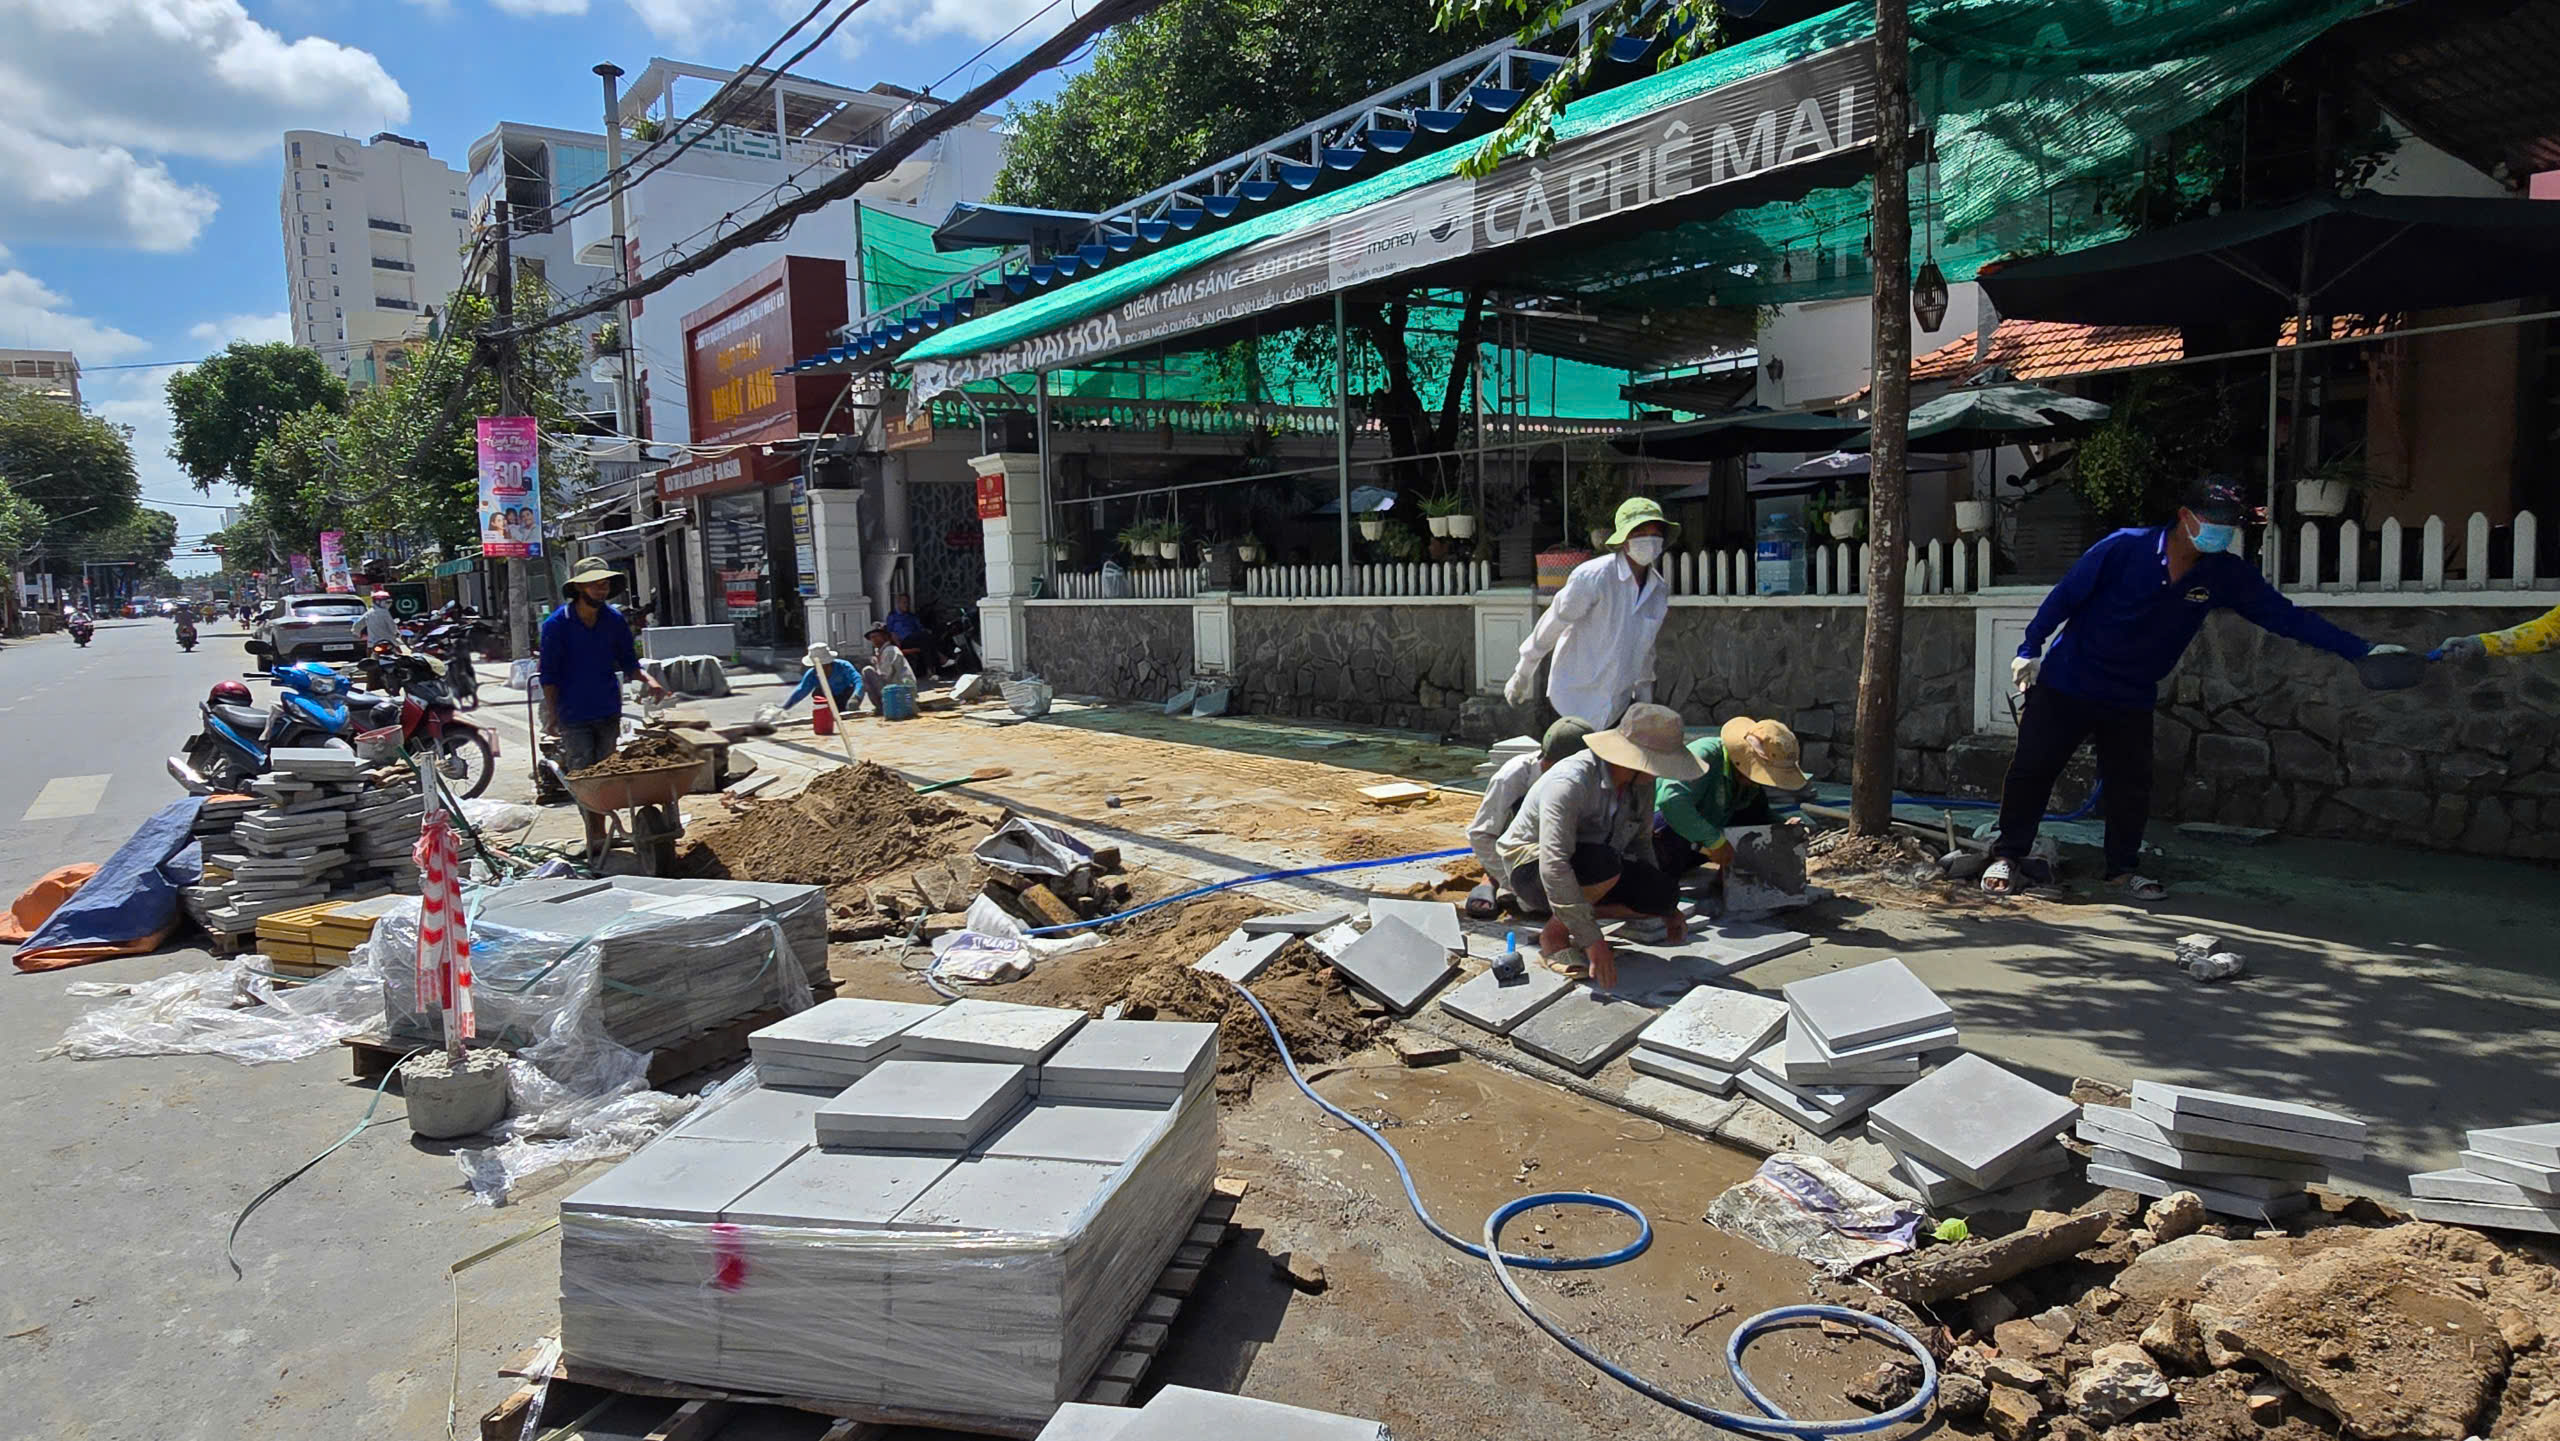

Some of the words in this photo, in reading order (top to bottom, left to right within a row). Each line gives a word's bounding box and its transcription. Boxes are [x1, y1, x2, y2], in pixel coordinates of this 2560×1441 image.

[1484, 166, 1555, 242] CÀ
[1568, 119, 1692, 222] PHÊ
[1712, 85, 1855, 182] MAI
[1367, 229, 1420, 255] money
[1161, 282, 1193, 309] TÂM
[1195, 269, 1240, 299] SÁNG
[1231, 300, 1255, 317] NINH
[1022, 335, 1067, 369] MAI
[1068, 314, 1121, 356] HOA
[747, 364, 777, 412] ANH
[494, 461, 522, 488] 30
